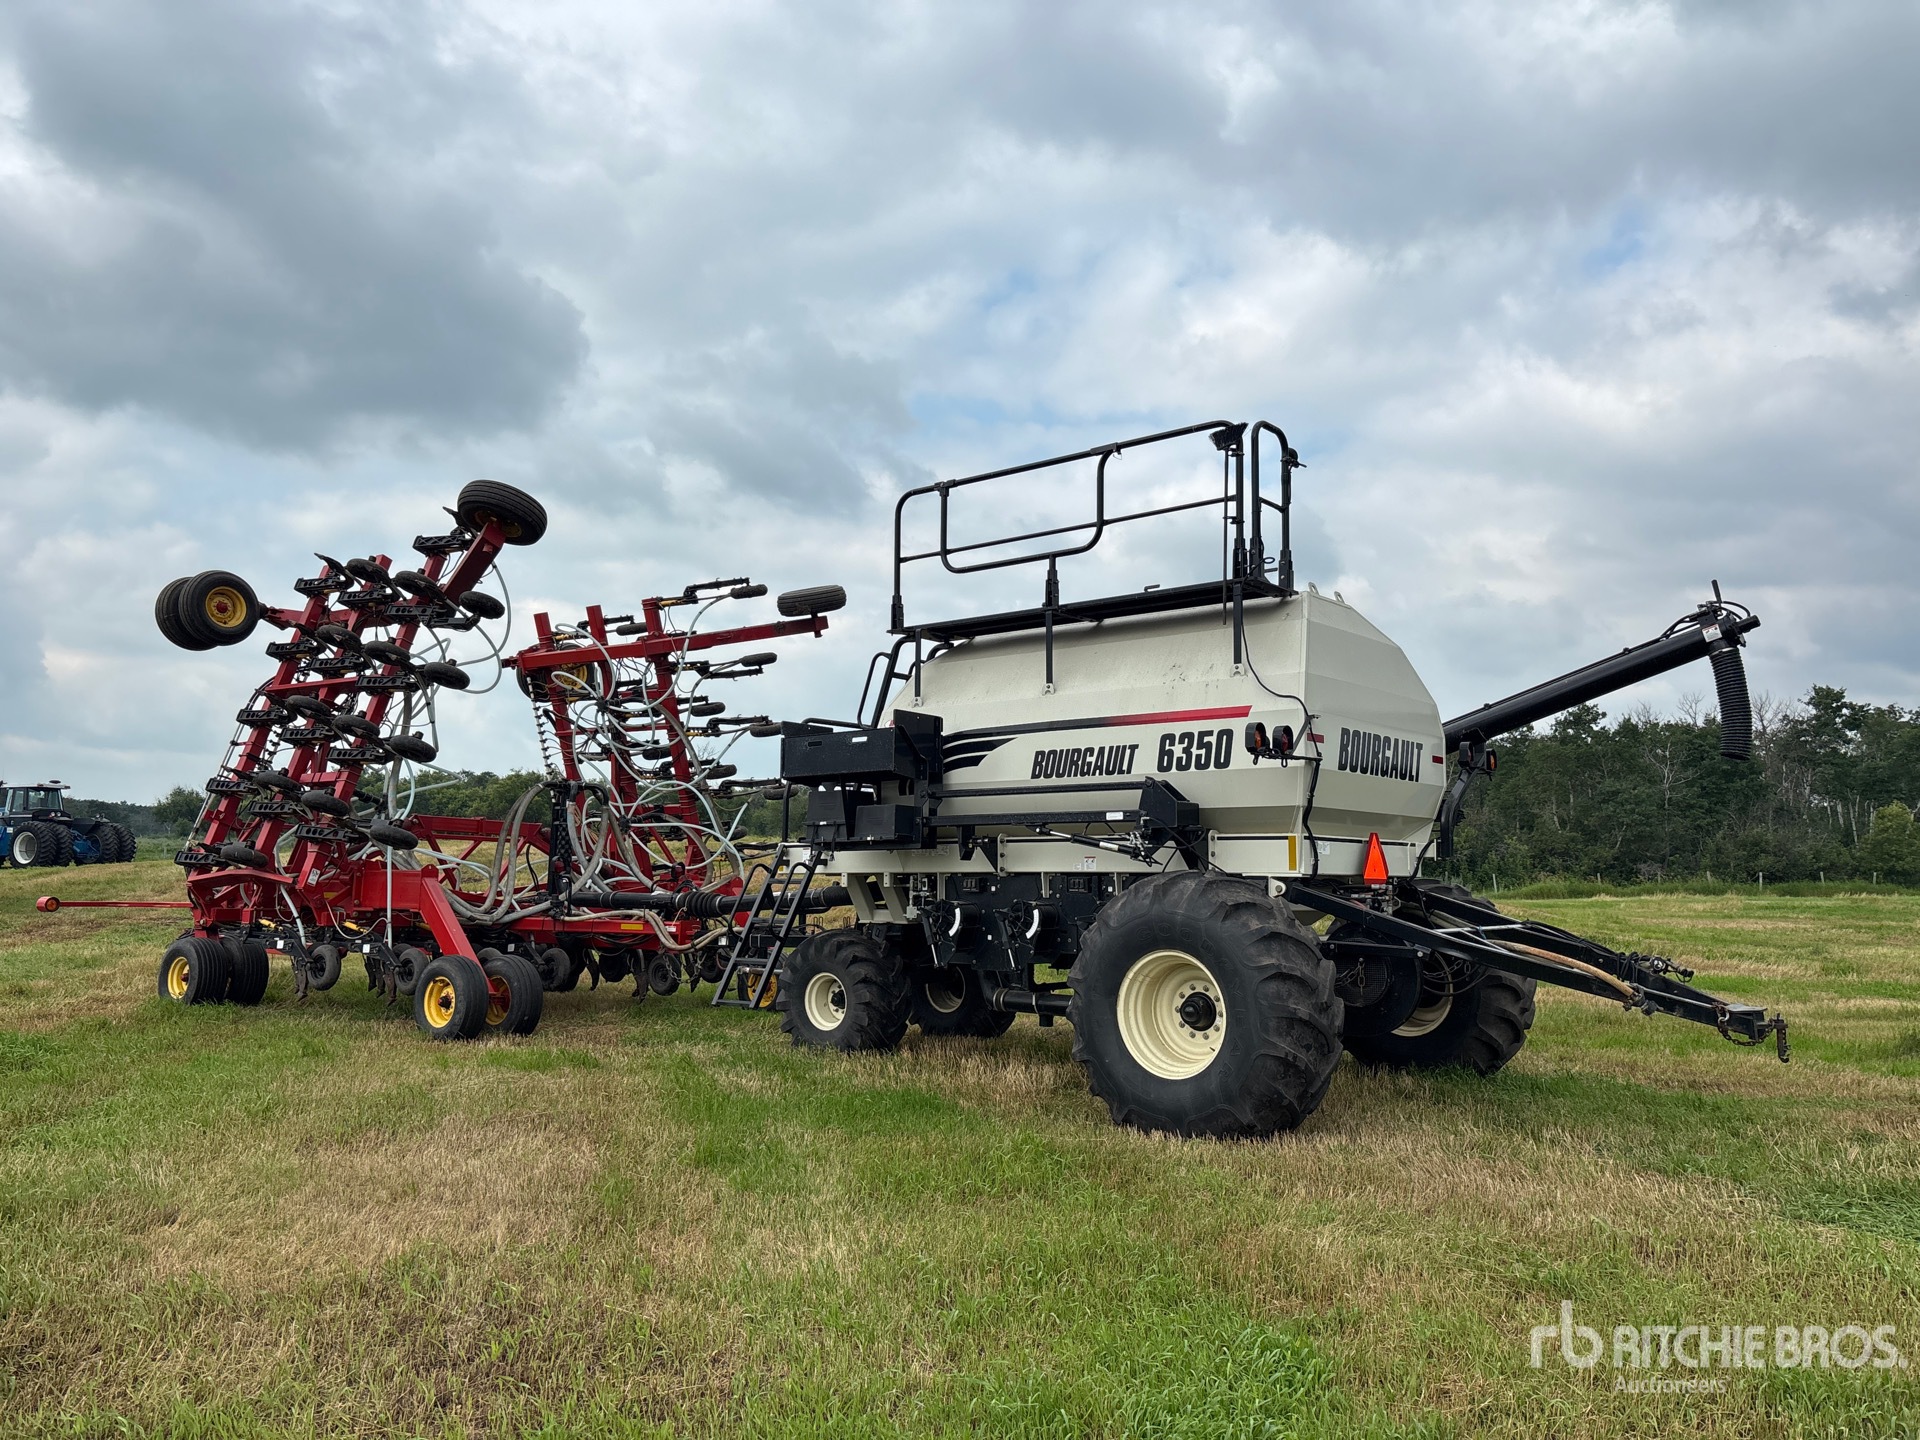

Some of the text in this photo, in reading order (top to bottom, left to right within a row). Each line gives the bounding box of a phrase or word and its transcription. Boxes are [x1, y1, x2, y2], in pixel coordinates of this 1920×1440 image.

[1031, 728, 1234, 780] BOURGAULT 6350
[1338, 727, 1424, 783] BOURGAULT
